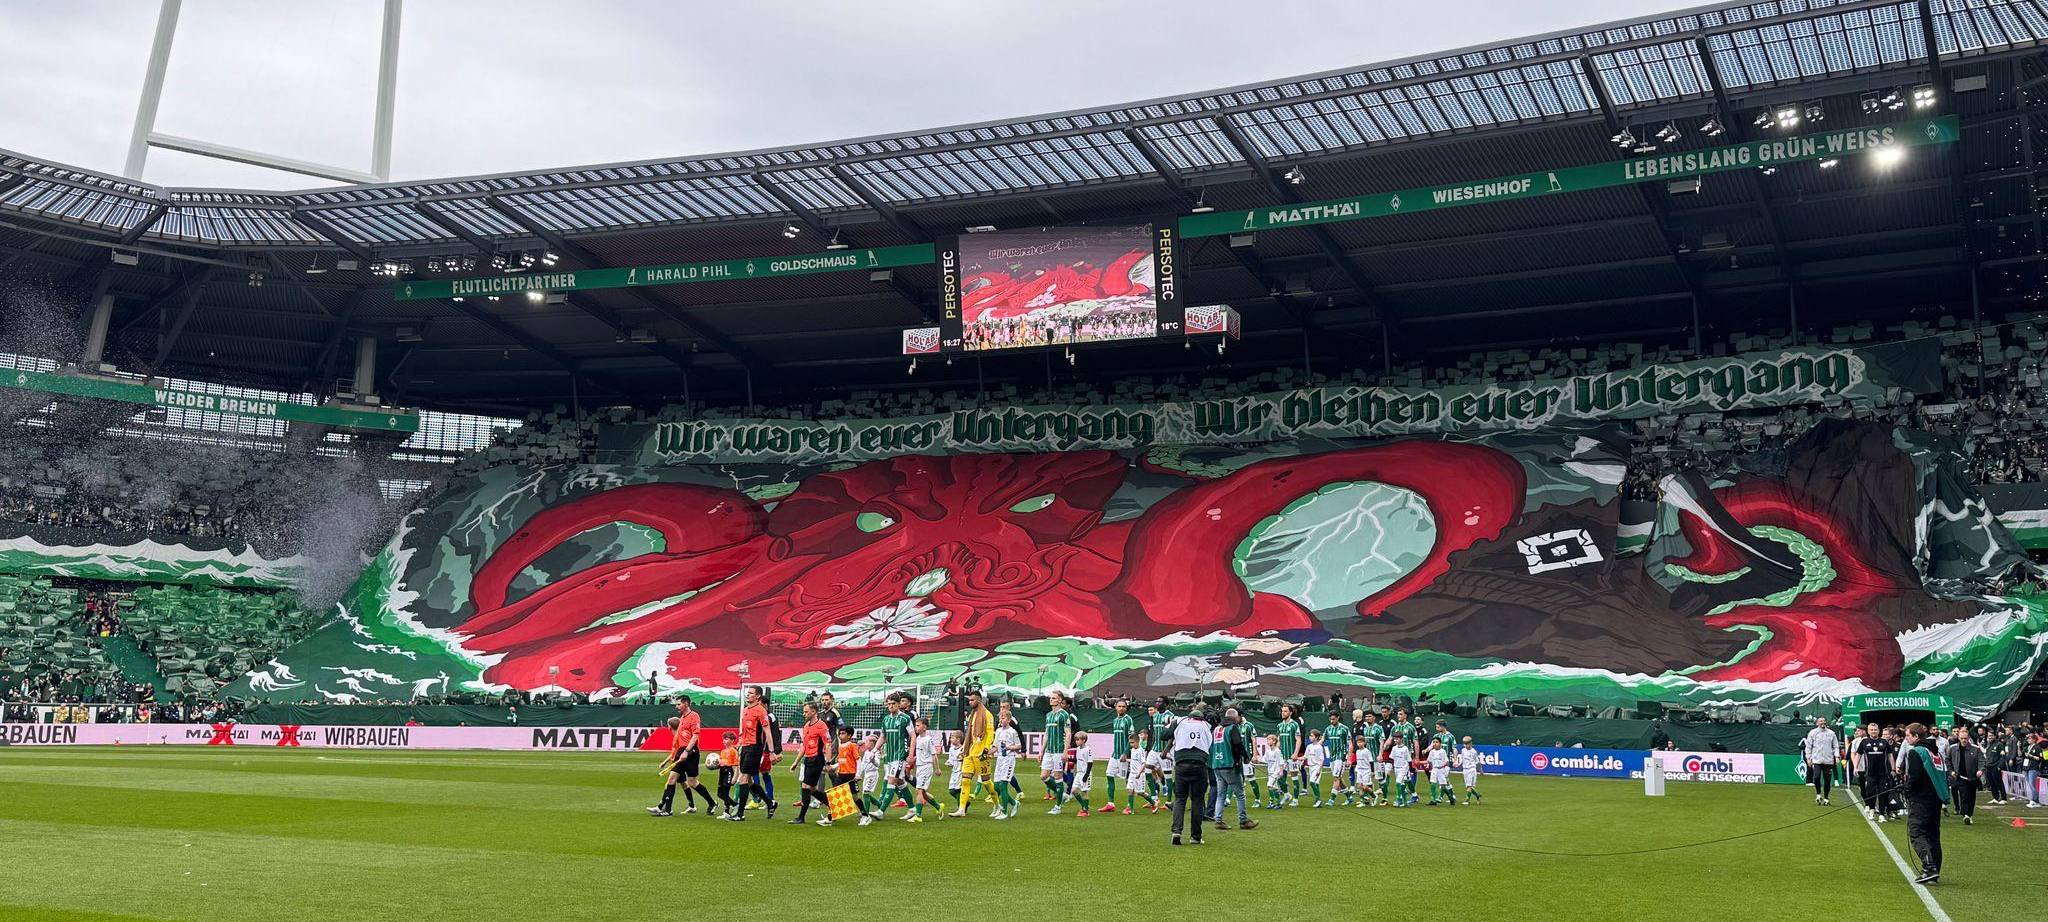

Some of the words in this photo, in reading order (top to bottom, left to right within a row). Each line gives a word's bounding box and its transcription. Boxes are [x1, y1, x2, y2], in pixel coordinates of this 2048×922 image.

[1625, 146, 1751, 180] LEBENSLANG
[1758, 127, 1896, 161] GRÜN-WEISS
[1432, 178, 1531, 204] WIESENHOF
[1268, 201, 1361, 224] MATTHÄI
[647, 266, 698, 281] HARALD
[702, 264, 731, 278] PIHL
[770, 254, 857, 272] GOLDSCHMAUS
[1159, 228, 1174, 301] PERSOTEC
[452, 273, 576, 294] FLUTLICHTPARTNER
[942, 250, 956, 319] PERSOTEC
[154, 389, 215, 409] WERDER
[219, 398, 277, 416] BREMEN
[1192, 396, 1273, 438] Wir
[1281, 387, 1442, 434] bleiben
[1450, 385, 1561, 428] euer
[1572, 351, 1856, 411] Untergang
[656, 420, 727, 456] Wir
[732, 423, 852, 456] waren
[859, 418, 943, 452] euer
[950, 405, 1156, 451] Untergang
[1864, 697, 1930, 707] WESERSTADION
[325, 727, 409, 746] WIRBAUEN
[1189, 731, 1201, 740] 03
[1551, 754, 1623, 770] combi.de
[1698, 772, 1762, 783] sunseeker
